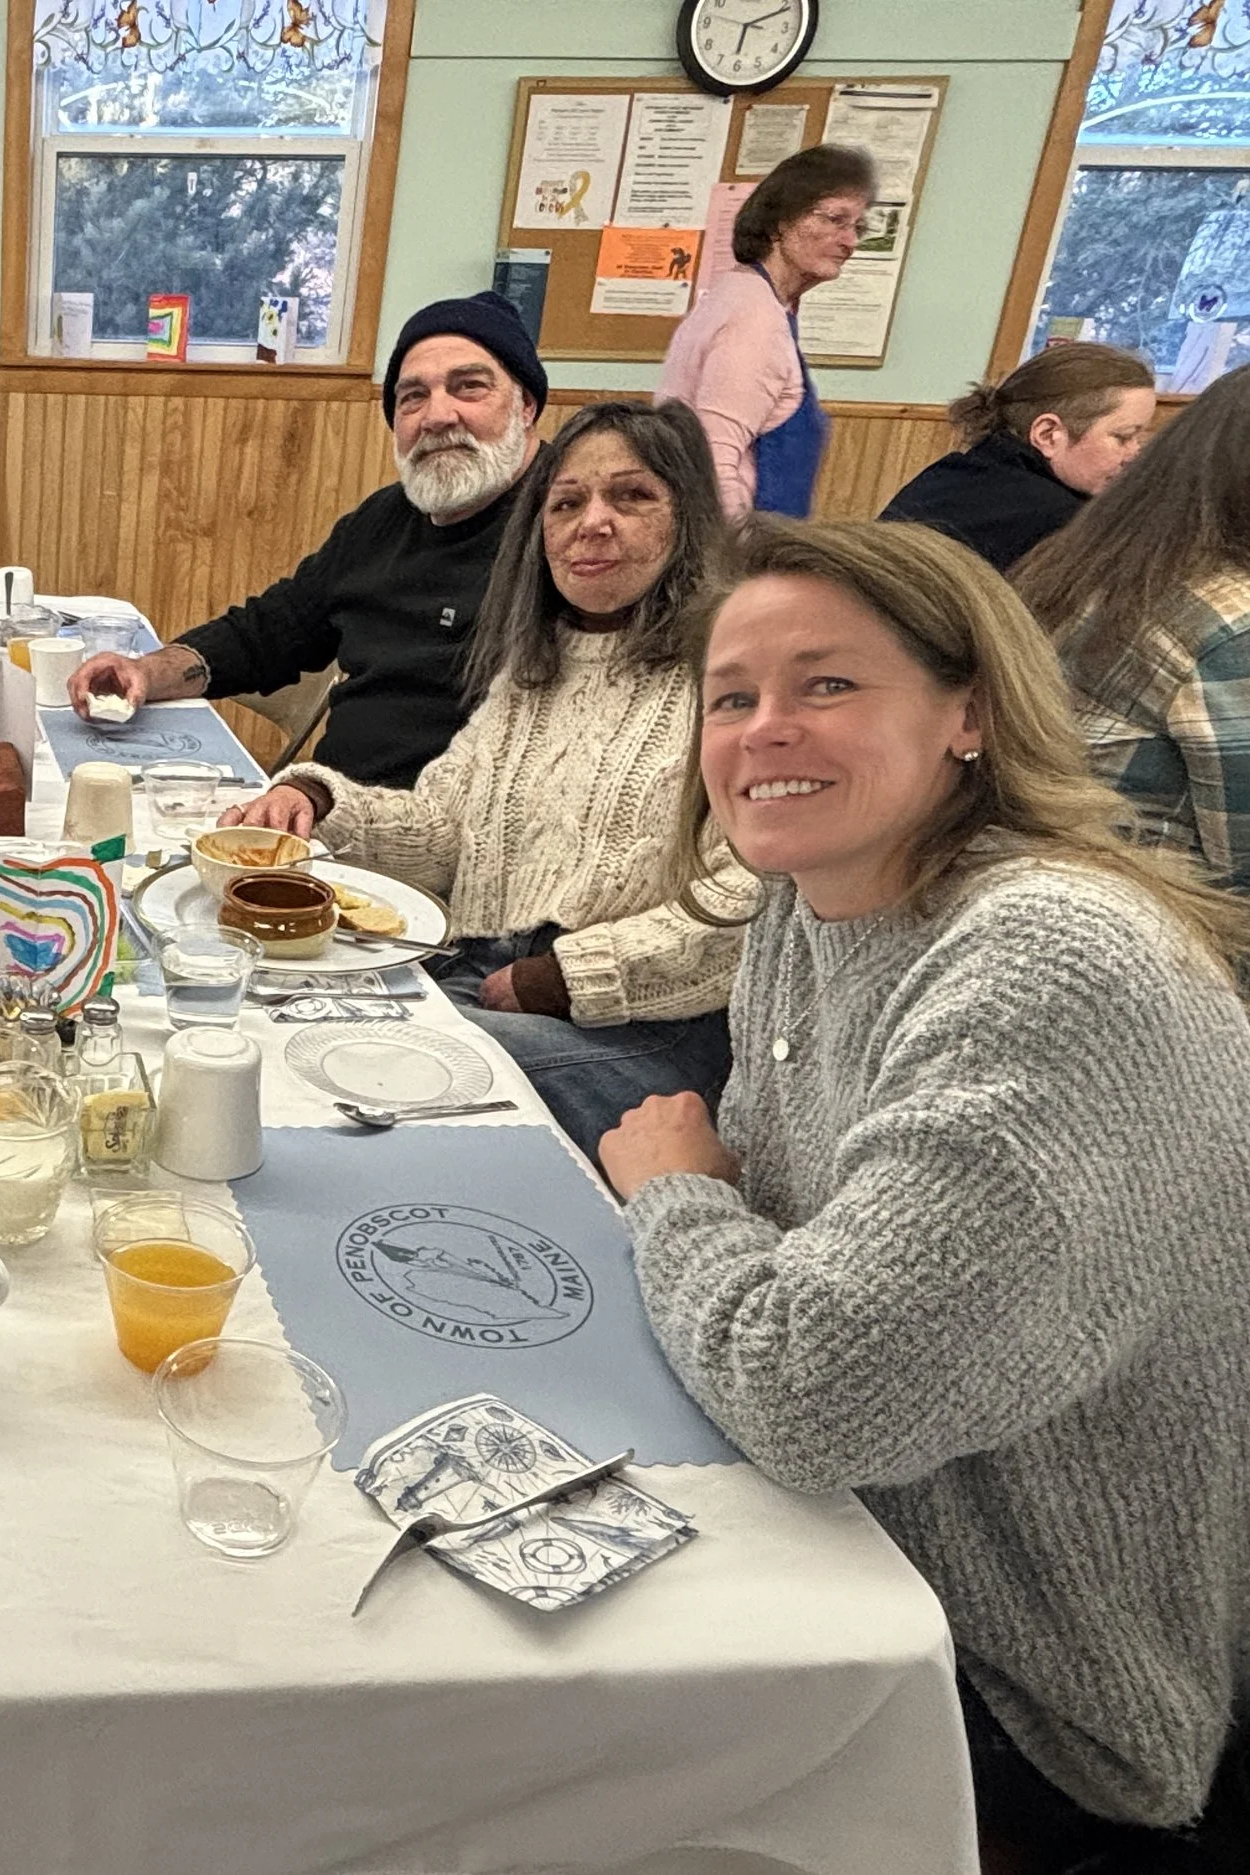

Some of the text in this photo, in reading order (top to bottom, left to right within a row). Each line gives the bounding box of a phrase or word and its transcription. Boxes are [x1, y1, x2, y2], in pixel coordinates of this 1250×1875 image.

[714, 0, 726, 8] 10
[703, 17, 711, 28] 9
[781, 21, 789, 34] 3
[705, 39, 713, 50] 8
[771, 43, 778, 53] 4
[717, 54, 725, 65] 7
[754, 57, 762, 68] 5
[733, 60, 742, 72] 6
[345, 1206, 528, 1344] TOWN OF PENOBSCOT
[527, 1239, 585, 1301] MAINE
